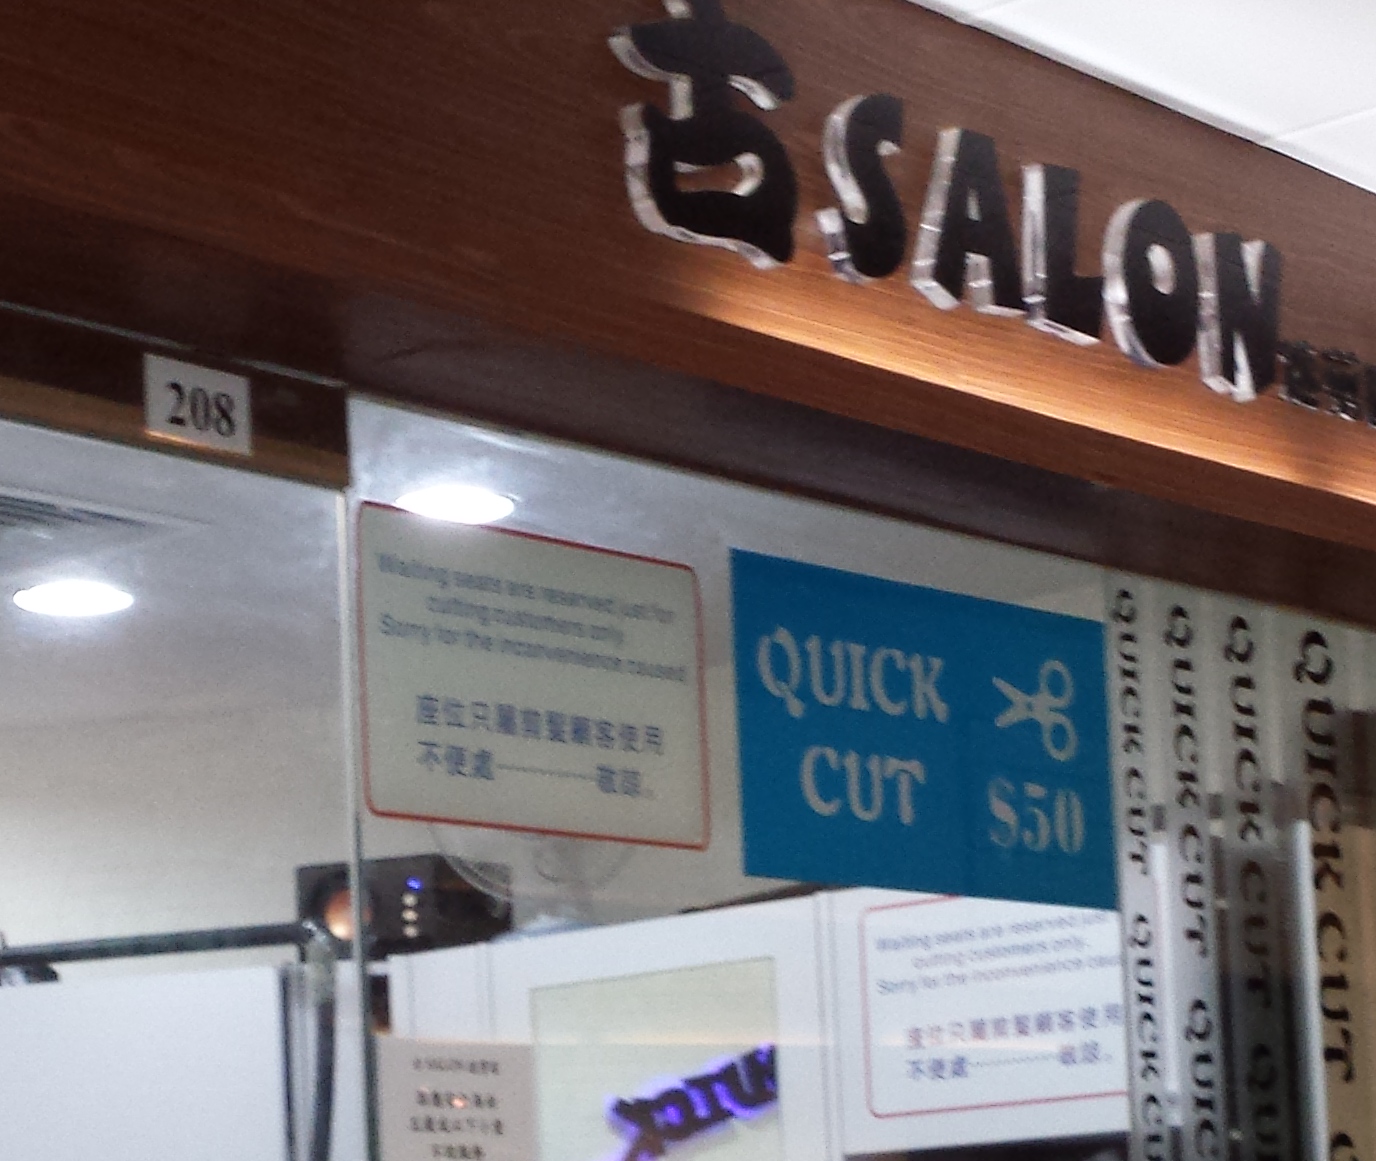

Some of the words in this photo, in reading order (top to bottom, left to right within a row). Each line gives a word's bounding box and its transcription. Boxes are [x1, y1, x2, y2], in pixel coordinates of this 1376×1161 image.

[816, 92, 1284, 402] SALON
[165, 381, 236, 438] 208
[379, 611, 432, 645] Sorry
[463, 629, 494, 650] the
[758, 626, 950, 724] QUICK
[1109, 587, 1144, 755] QUICK
[1164, 604, 1201, 809] QUICK
[800, 744, 926, 827] CUT
[1224, 615, 1266, 846] QUICK
[1292, 629, 1347, 892] QUICK
[988, 777, 1086, 854] $50
[1126, 767, 1150, 878] CUT
[1179, 822, 1209, 961] CUT
[1128, 913, 1160, 1082] QUICK
[1239, 860, 1274, 1012] CUT
[1313, 909, 1355, 1085] CUT
